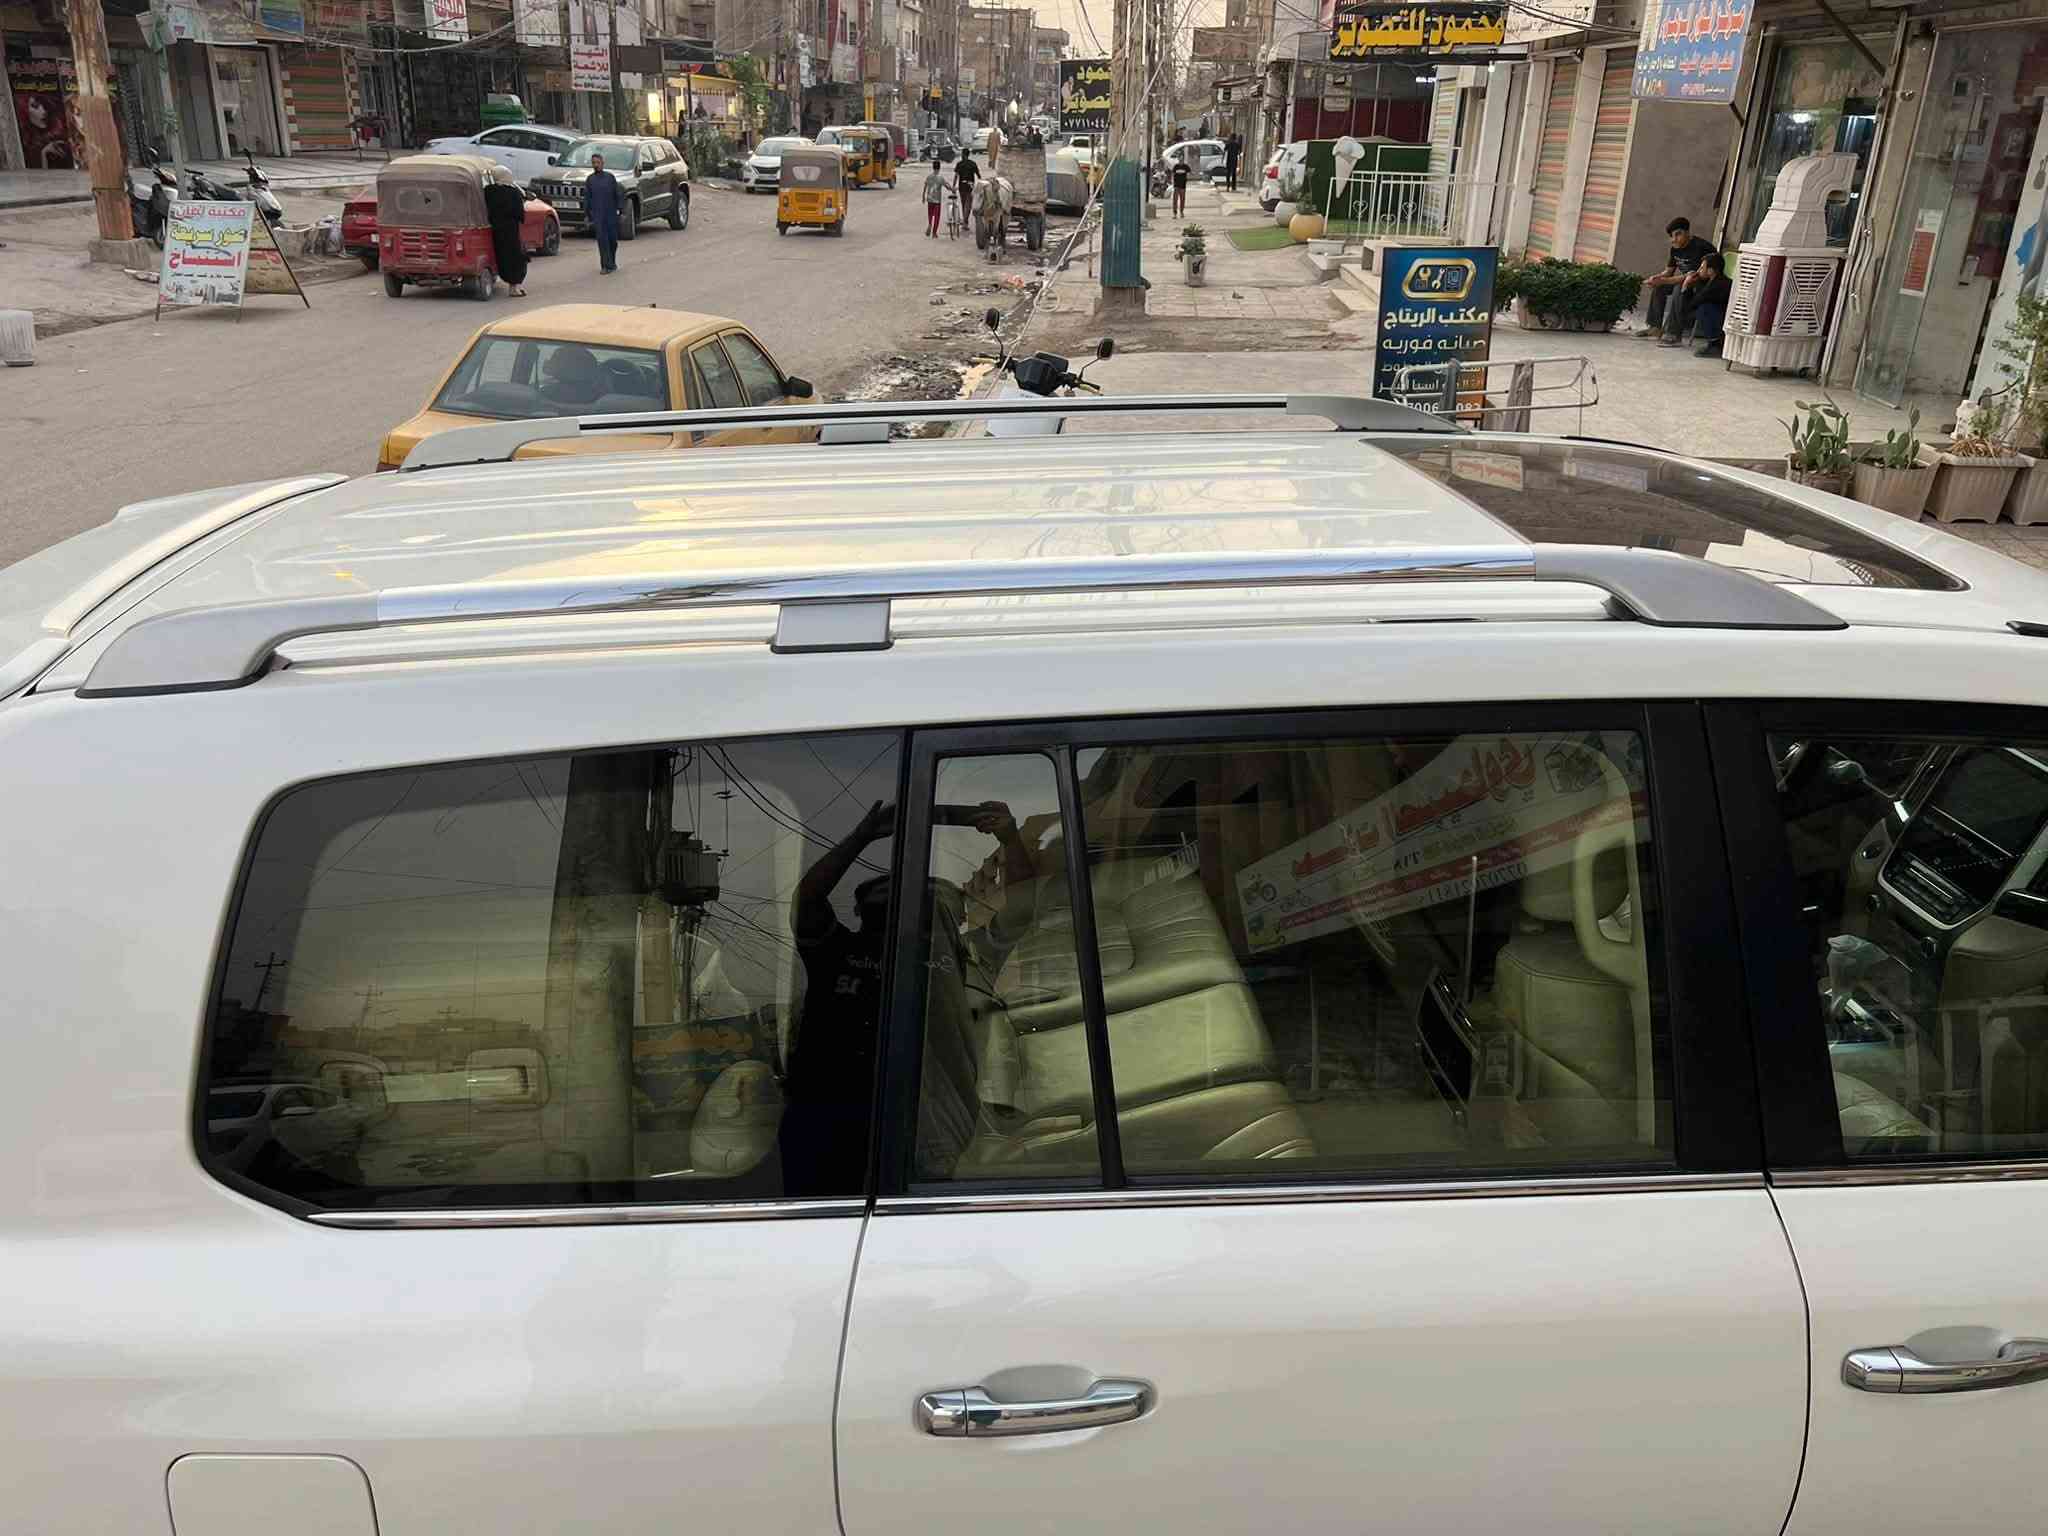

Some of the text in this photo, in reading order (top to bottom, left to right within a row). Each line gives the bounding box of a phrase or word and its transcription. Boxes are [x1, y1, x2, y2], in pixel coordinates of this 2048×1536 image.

[1331, 8, 1426, 57] للتصوير
[1429, 14, 1505, 53] محمود
[1384, 307, 1488, 330] مكتب الريتاج
